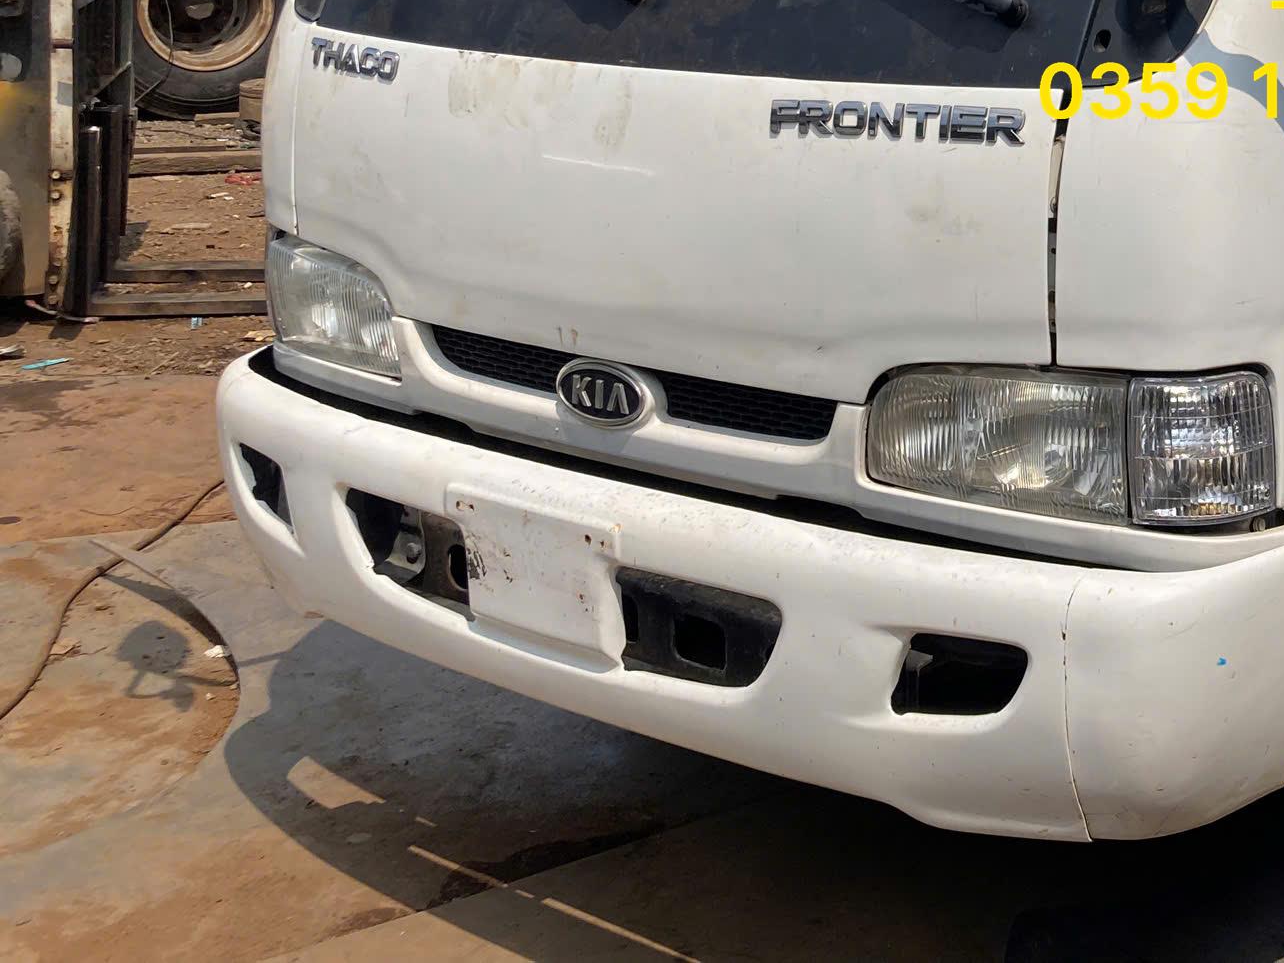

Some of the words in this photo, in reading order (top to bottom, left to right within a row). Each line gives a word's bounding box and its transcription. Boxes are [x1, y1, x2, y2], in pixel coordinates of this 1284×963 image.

[312, 37, 400, 82] THACO
[769, 99, 1026, 145] FRONTIER
[571, 374, 630, 415] KIA
